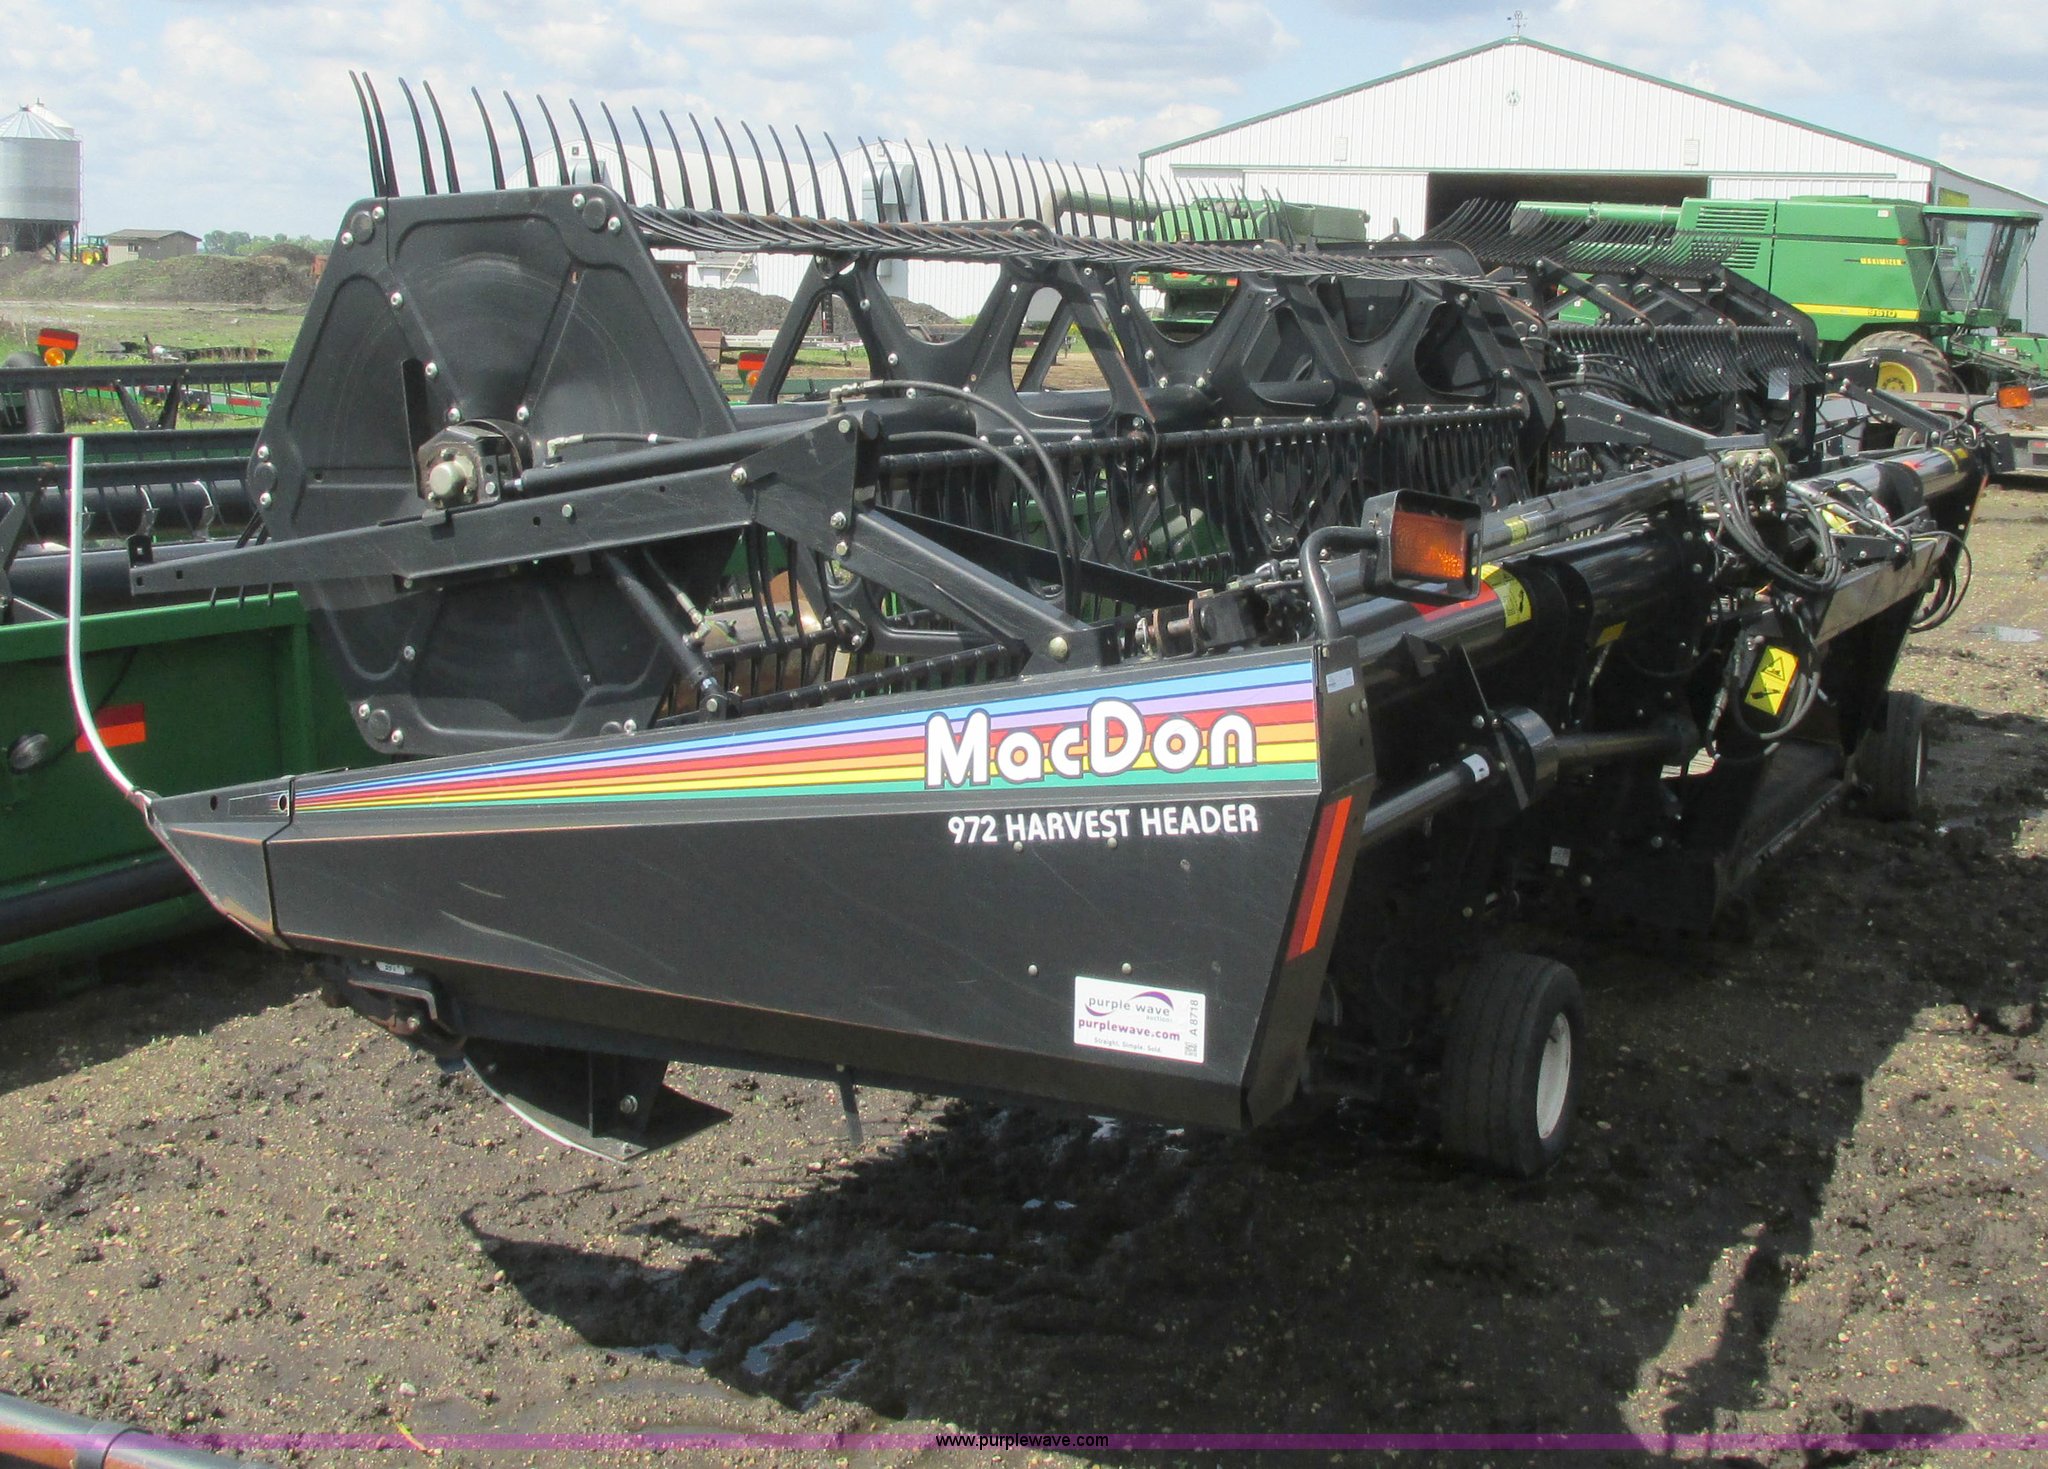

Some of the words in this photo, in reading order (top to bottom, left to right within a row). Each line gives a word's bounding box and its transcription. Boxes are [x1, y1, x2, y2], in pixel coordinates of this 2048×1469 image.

[925, 697, 1257, 790] MacDon
[947, 814, 998, 844] 972
[1006, 808, 1130, 842] HARVEST
[1141, 802, 1259, 836] HEADER
[1089, 997, 1131, 1010] purple
[1136, 1004, 1170, 1016] wave
[1190, 999, 1198, 1025] 8718
[1078, 1018, 1180, 1041] purplewave.com
